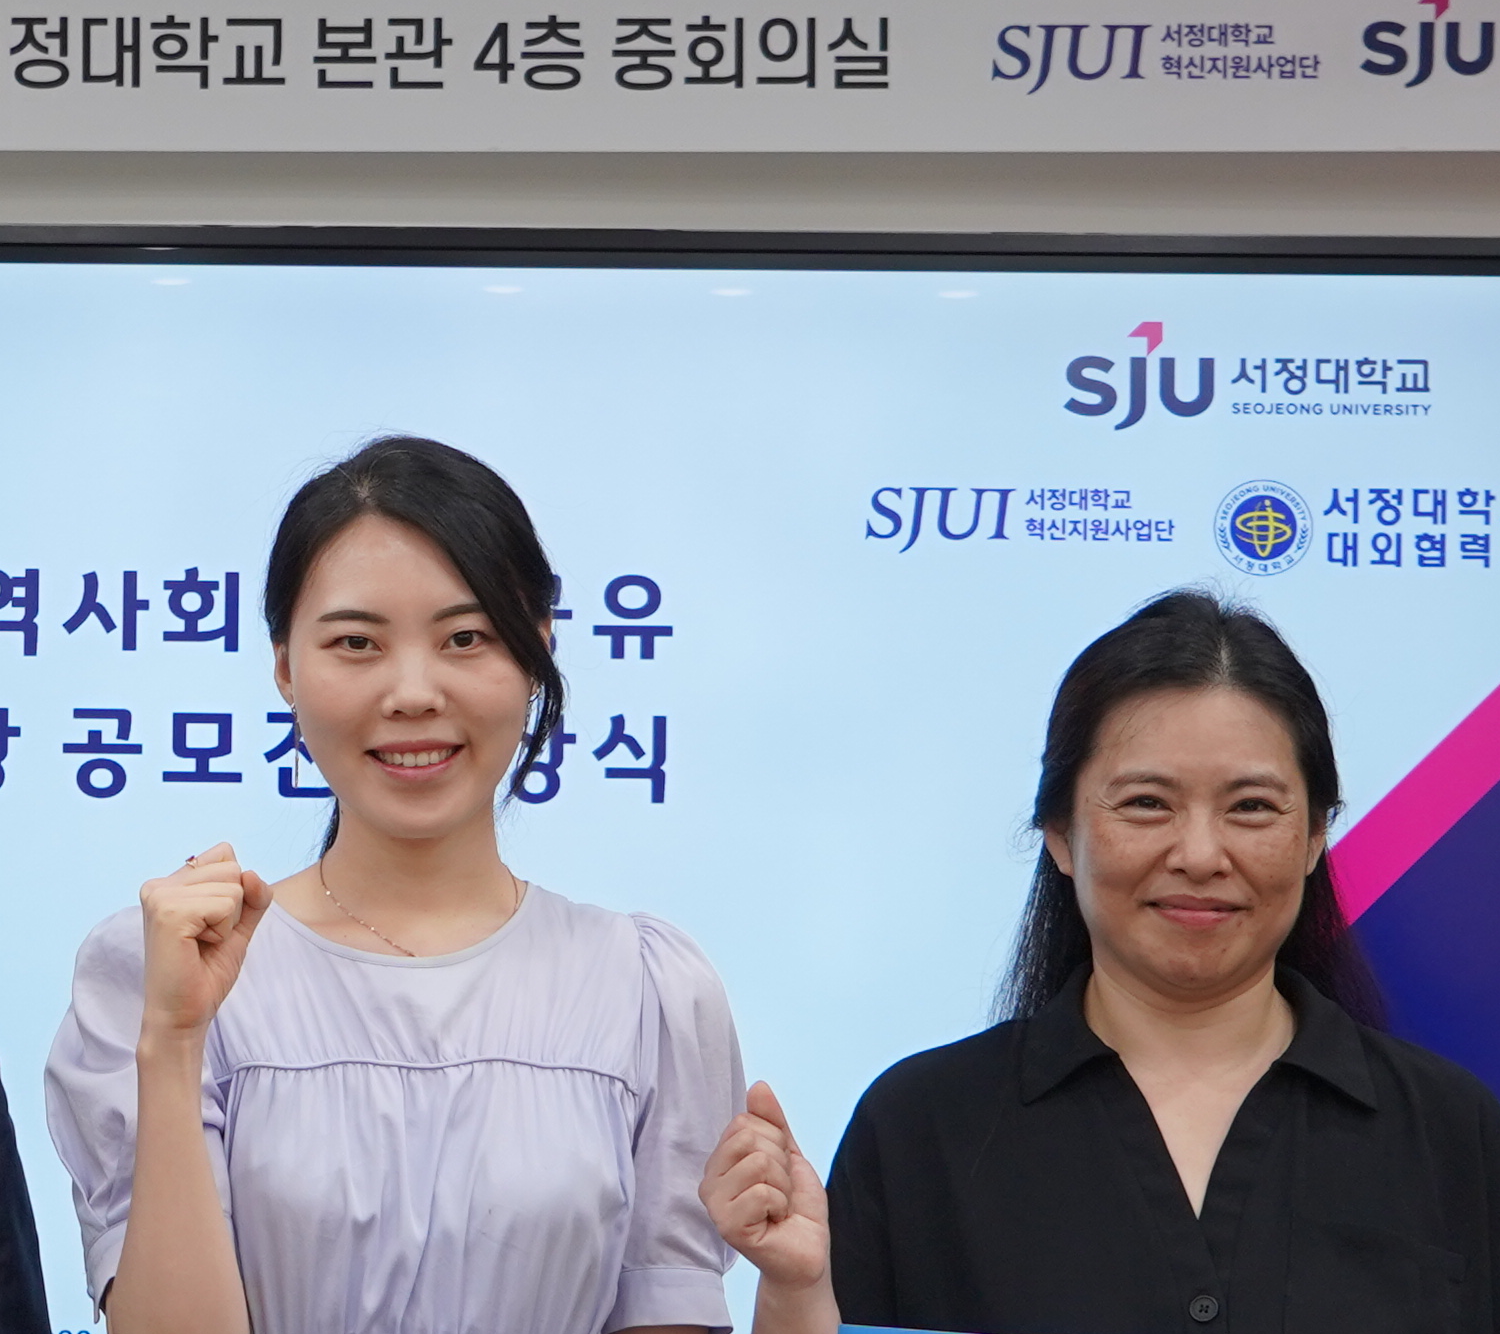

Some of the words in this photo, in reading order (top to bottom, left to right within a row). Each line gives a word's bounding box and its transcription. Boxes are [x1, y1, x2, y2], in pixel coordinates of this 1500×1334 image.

[1160, 22, 1275, 48] 서정대학교
[312, 16, 454, 90] 본관
[473, 14, 585, 91] 4층
[611, 14, 890, 91] 중회의실
[991, 24, 1153, 95] SJUI
[1160, 54, 1321, 80] 혁신지원사업단
[1230, 356, 1431, 396] 서정대학교
[1231, 402, 1324, 416] SEOJEONG
[1329, 403, 1432, 416] UNIVERSITY
[1025, 487, 1132, 512] 서정대학교
[865, 486, 1017, 554] SJUI
[1025, 517, 1175, 542] 혁신지원사업단
